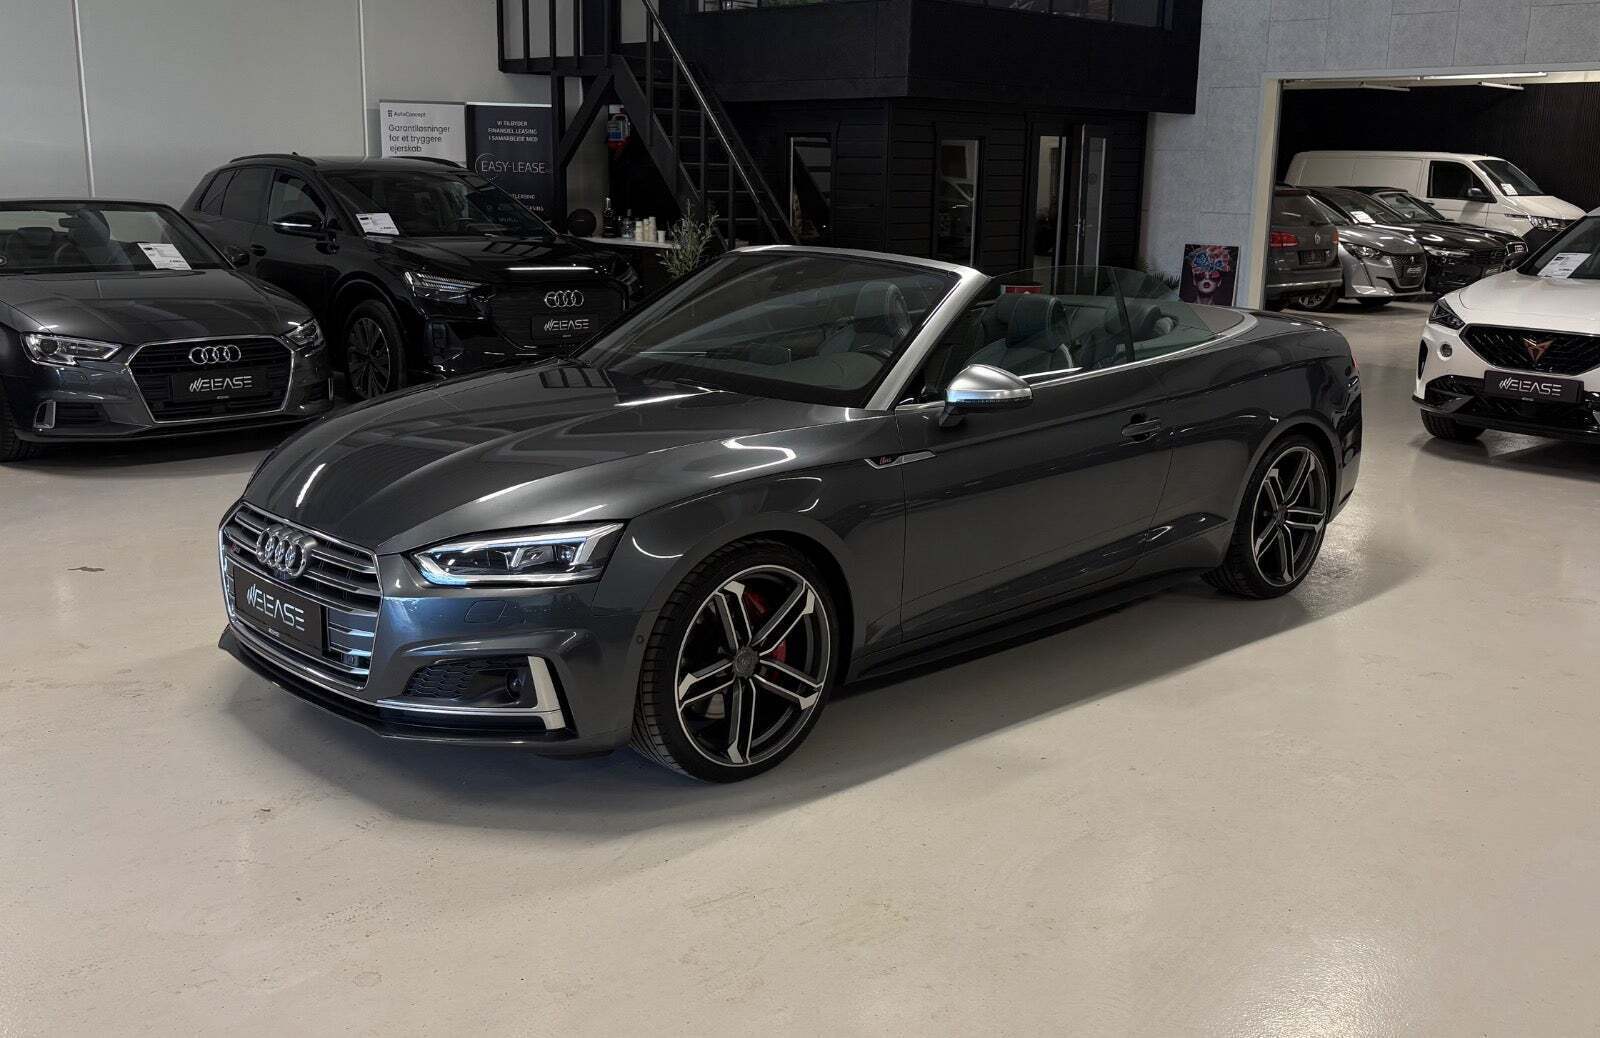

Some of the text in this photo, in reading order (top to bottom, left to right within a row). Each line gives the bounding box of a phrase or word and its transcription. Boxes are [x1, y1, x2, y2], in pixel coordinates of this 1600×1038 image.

[388, 124, 450, 135] Garantiløsninger
[389, 134, 400, 142] for
[410, 135, 442, 144] tryggere
[389, 144, 422, 154] ejerskab
[481, 160, 546, 174] EASY-LEASE
